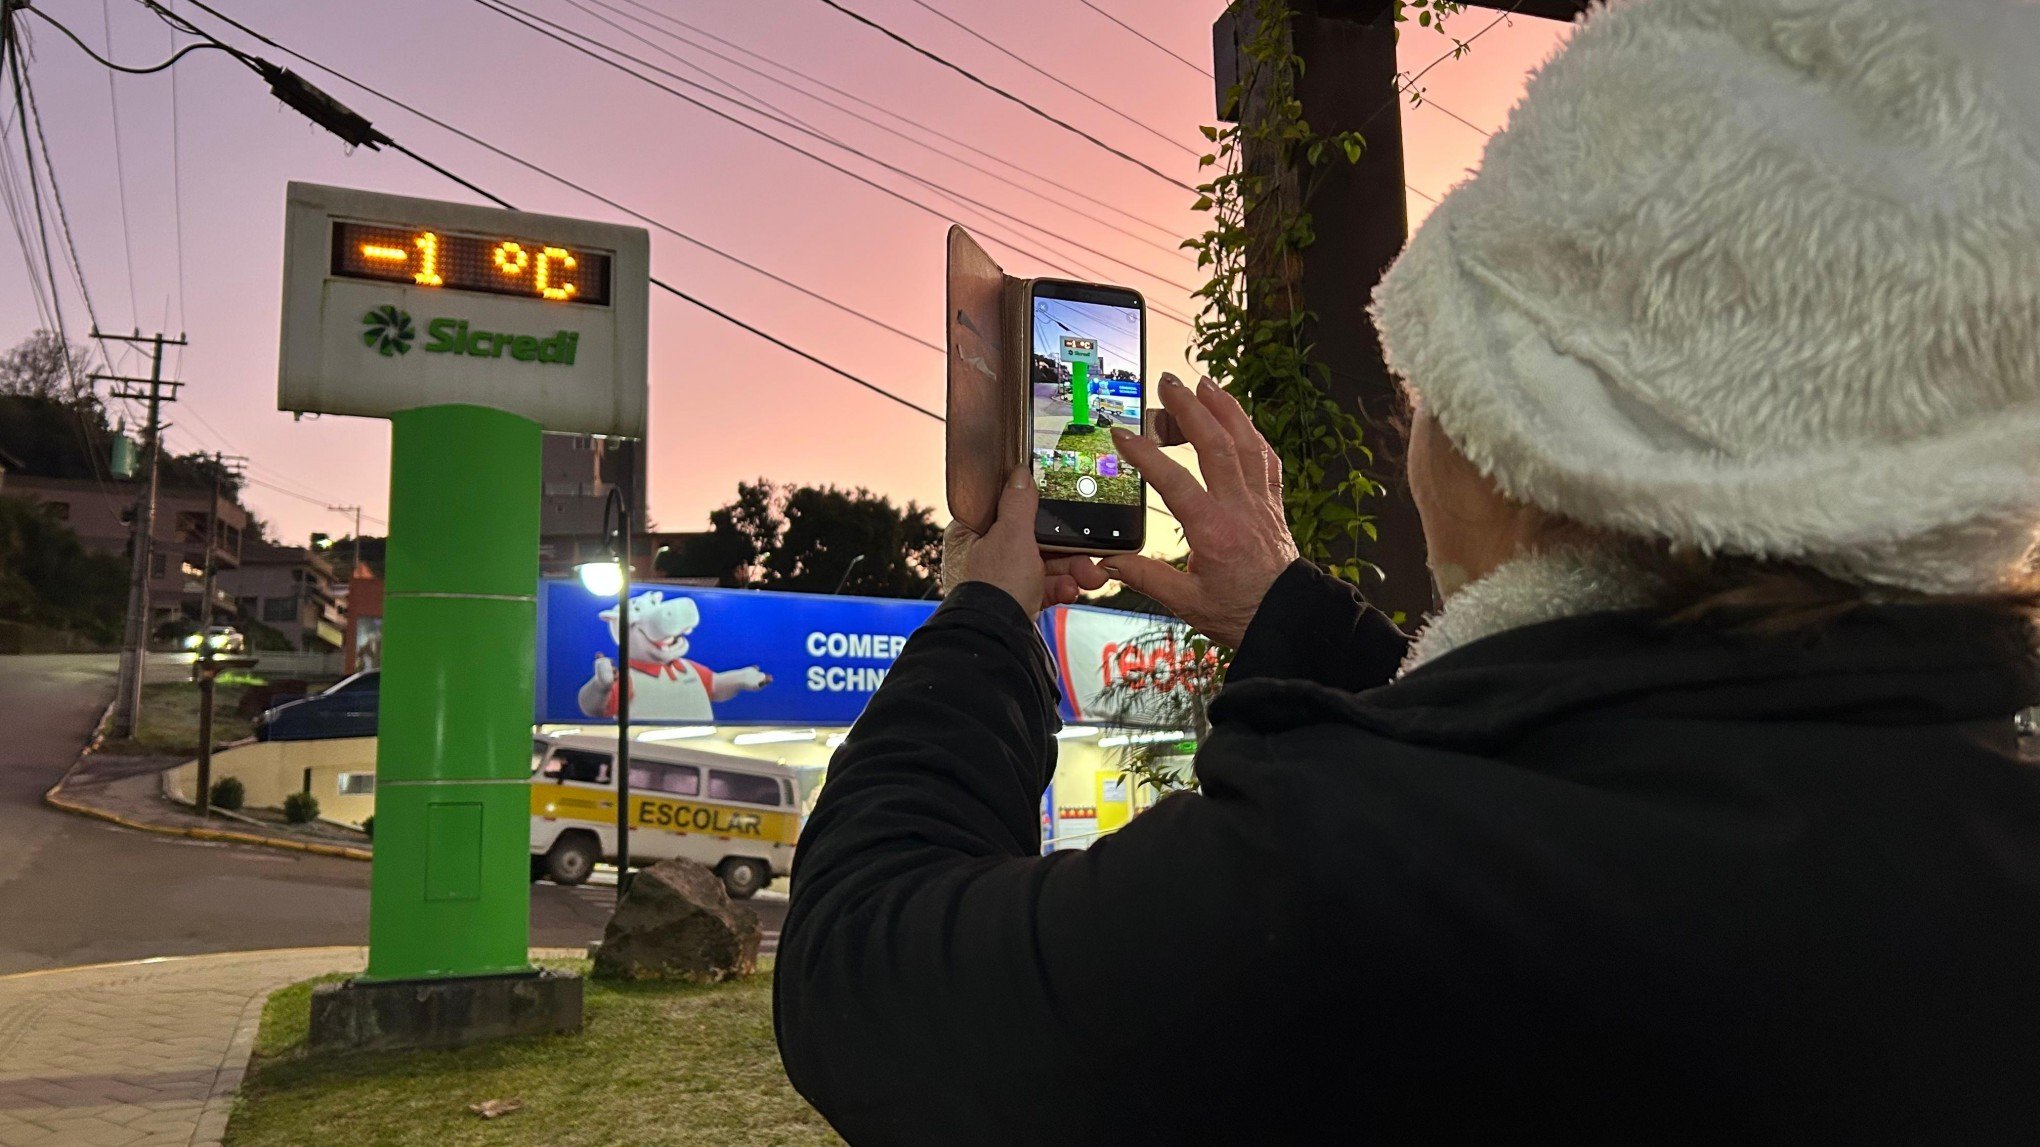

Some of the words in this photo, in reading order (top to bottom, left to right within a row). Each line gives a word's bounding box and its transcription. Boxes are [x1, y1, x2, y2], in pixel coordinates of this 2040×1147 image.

[362, 231, 443, 286] -1
[425, 317, 579, 366] Sicredi
[807, 665, 890, 692] SCHN
[638, 801, 761, 835] ESCOLAR
